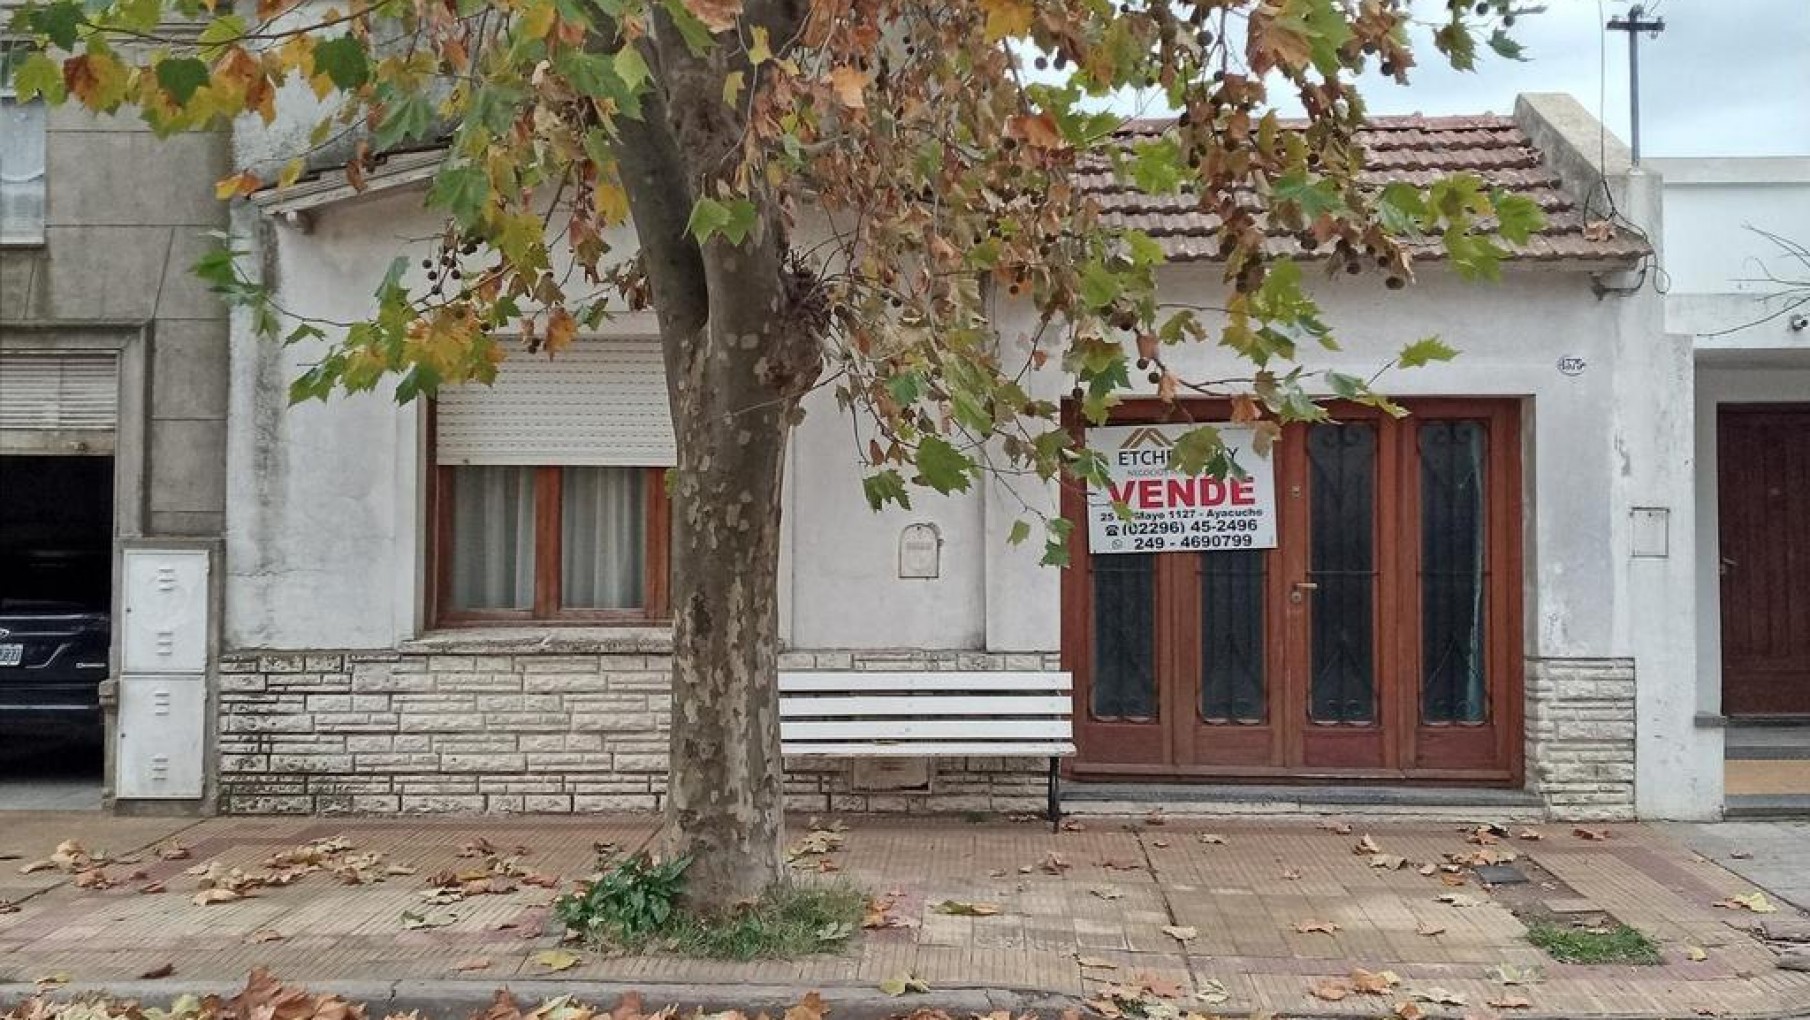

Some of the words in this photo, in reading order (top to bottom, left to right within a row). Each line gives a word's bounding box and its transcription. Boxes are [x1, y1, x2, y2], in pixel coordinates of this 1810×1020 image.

[1108, 476, 1255, 508] VENDE
[1100, 512, 1115, 522] 25
[1168, 509, 1195, 519] 1127
[1206, 508, 1263, 520] Ayacucho
[1122, 521, 1185, 536] (02296)
[1191, 519, 1257, 532] 45-2496
[1134, 537, 1164, 550] 249
[1180, 534, 1252, 548] 4690799
